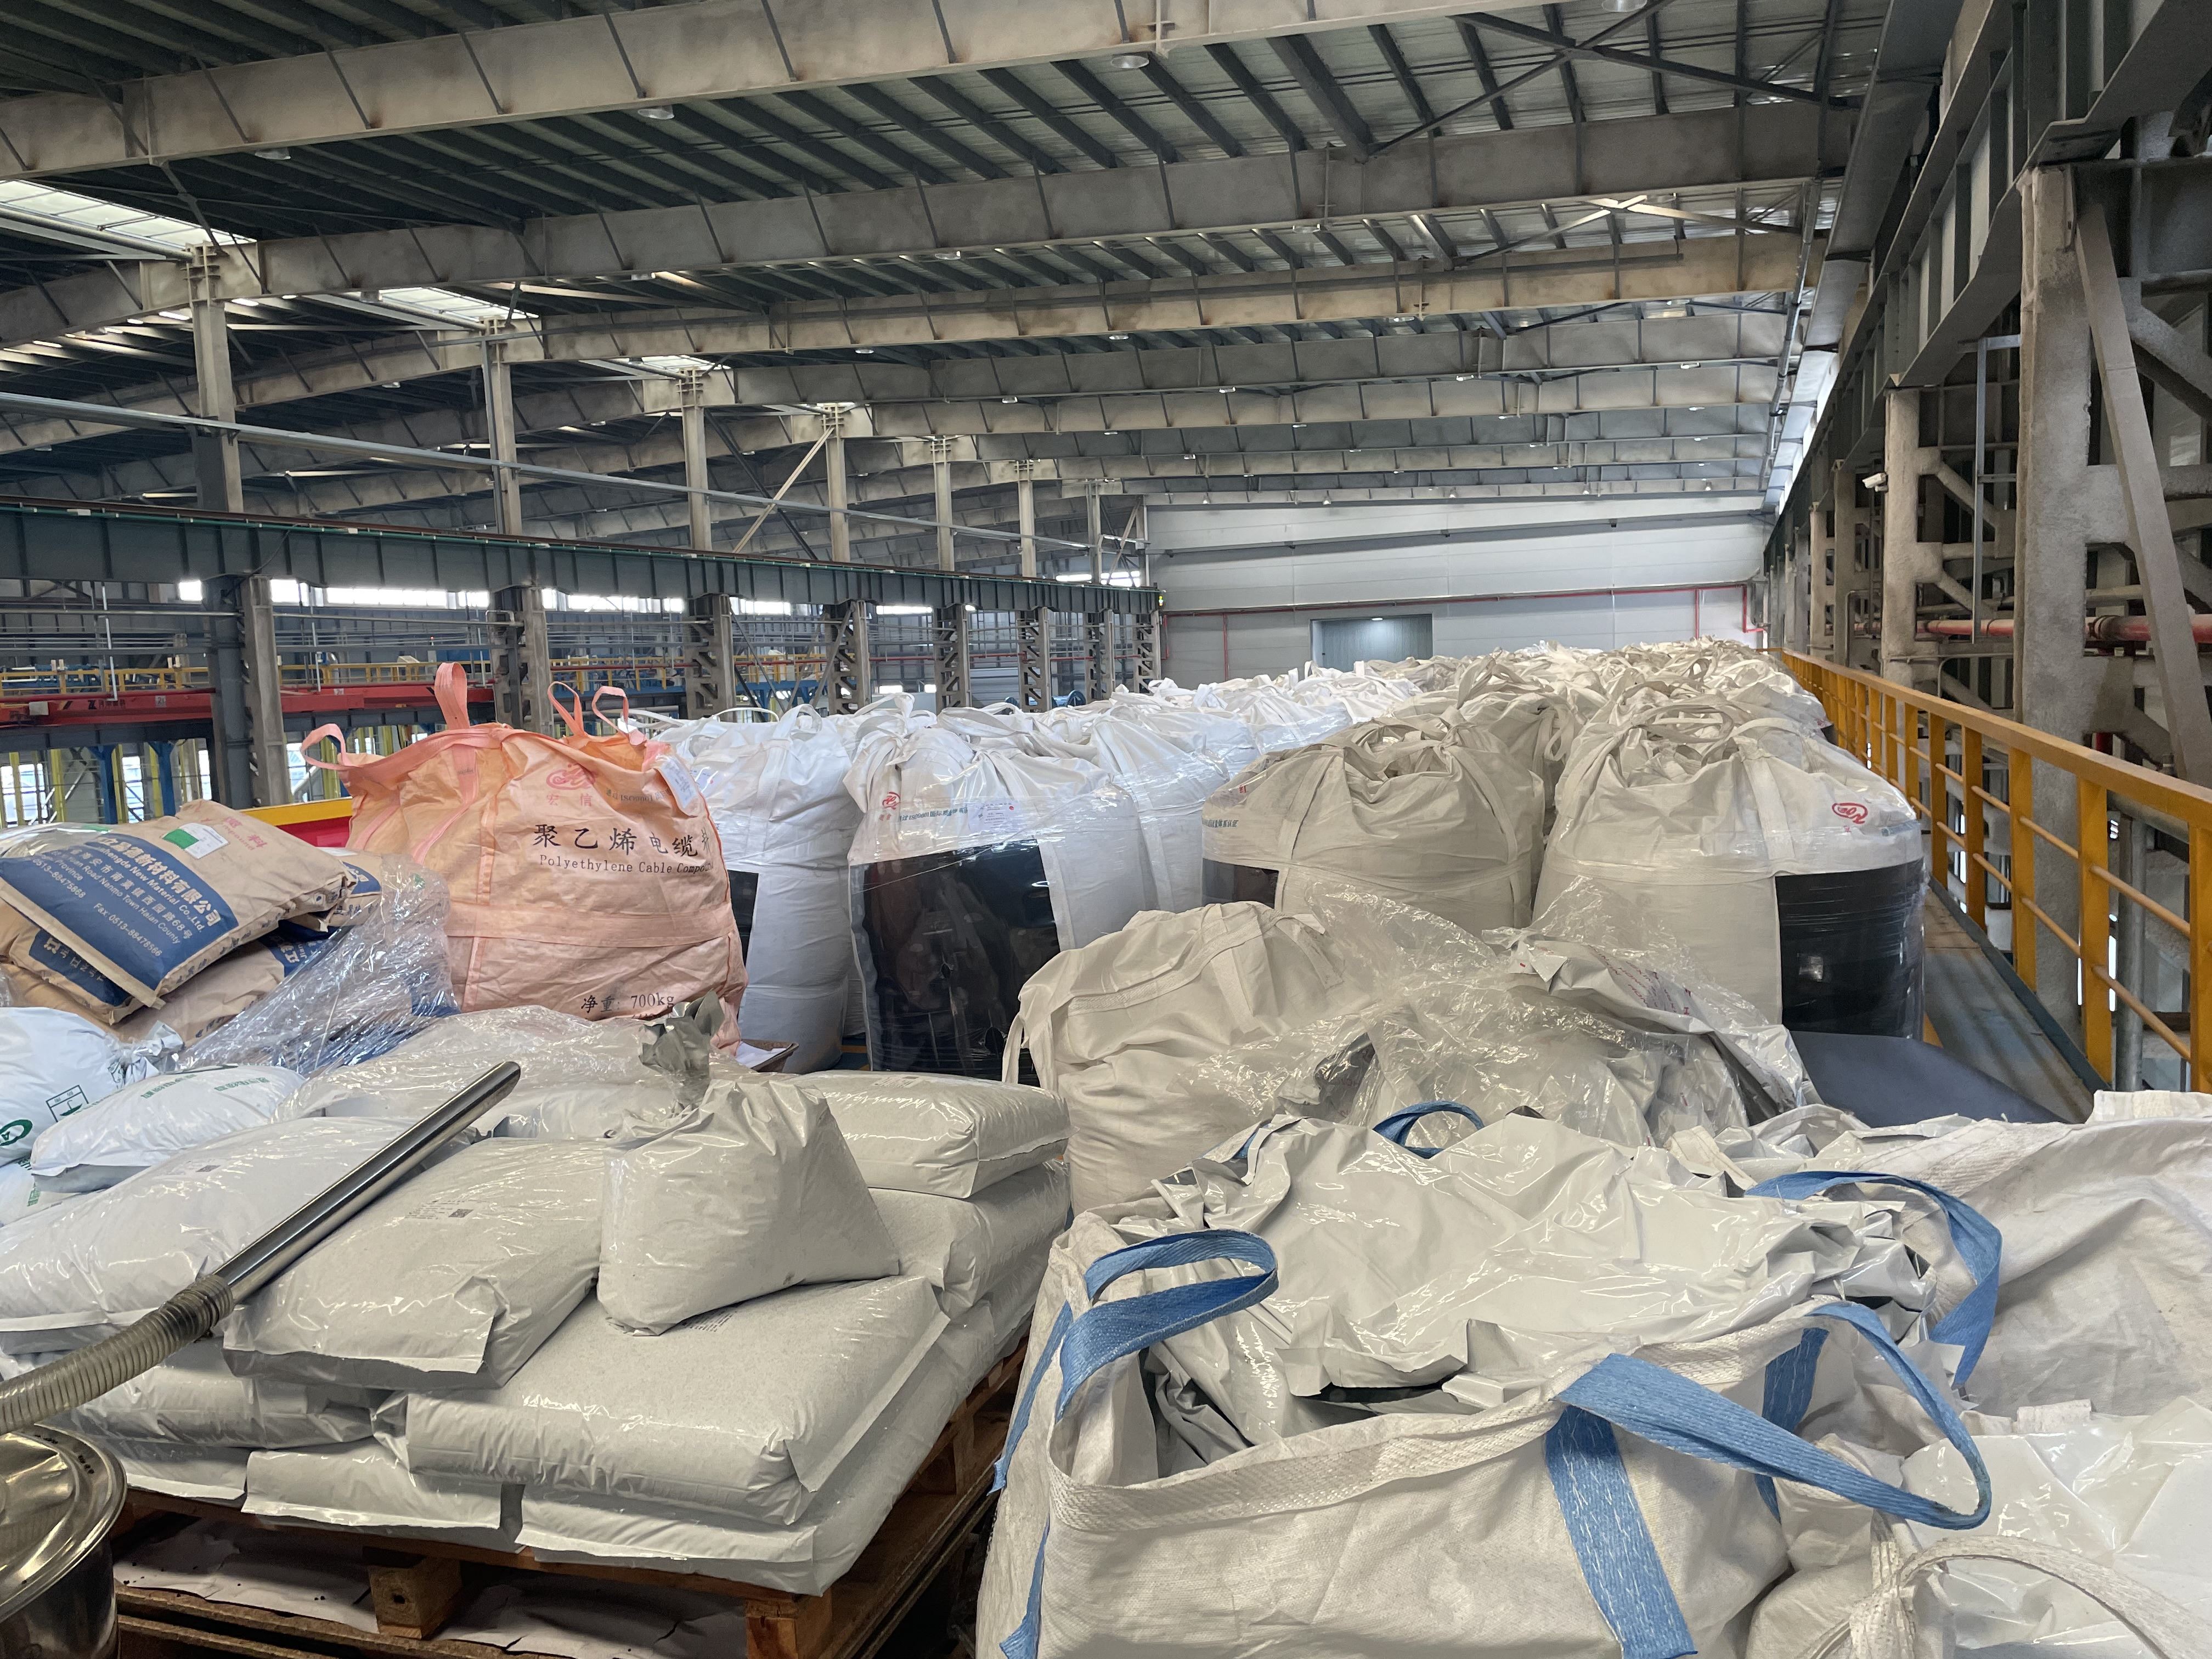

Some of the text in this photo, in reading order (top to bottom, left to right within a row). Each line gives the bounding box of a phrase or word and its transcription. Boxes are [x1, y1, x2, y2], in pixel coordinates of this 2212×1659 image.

[546, 794, 592, 807] 宏信
[55, 859, 83, 881] Province
[540, 854, 633, 872] Polyethylene
[639, 861, 672, 873] Cable
[82, 865, 102, 880] Road
[123, 895, 140, 910] Town
[158, 922, 180, 944] County
[129, 866, 149, 882] New
[147, 879, 180, 905] Material
[179, 905, 205, 933] Co.,Ltd.
[631, 992, 675, 1009] 700kg
